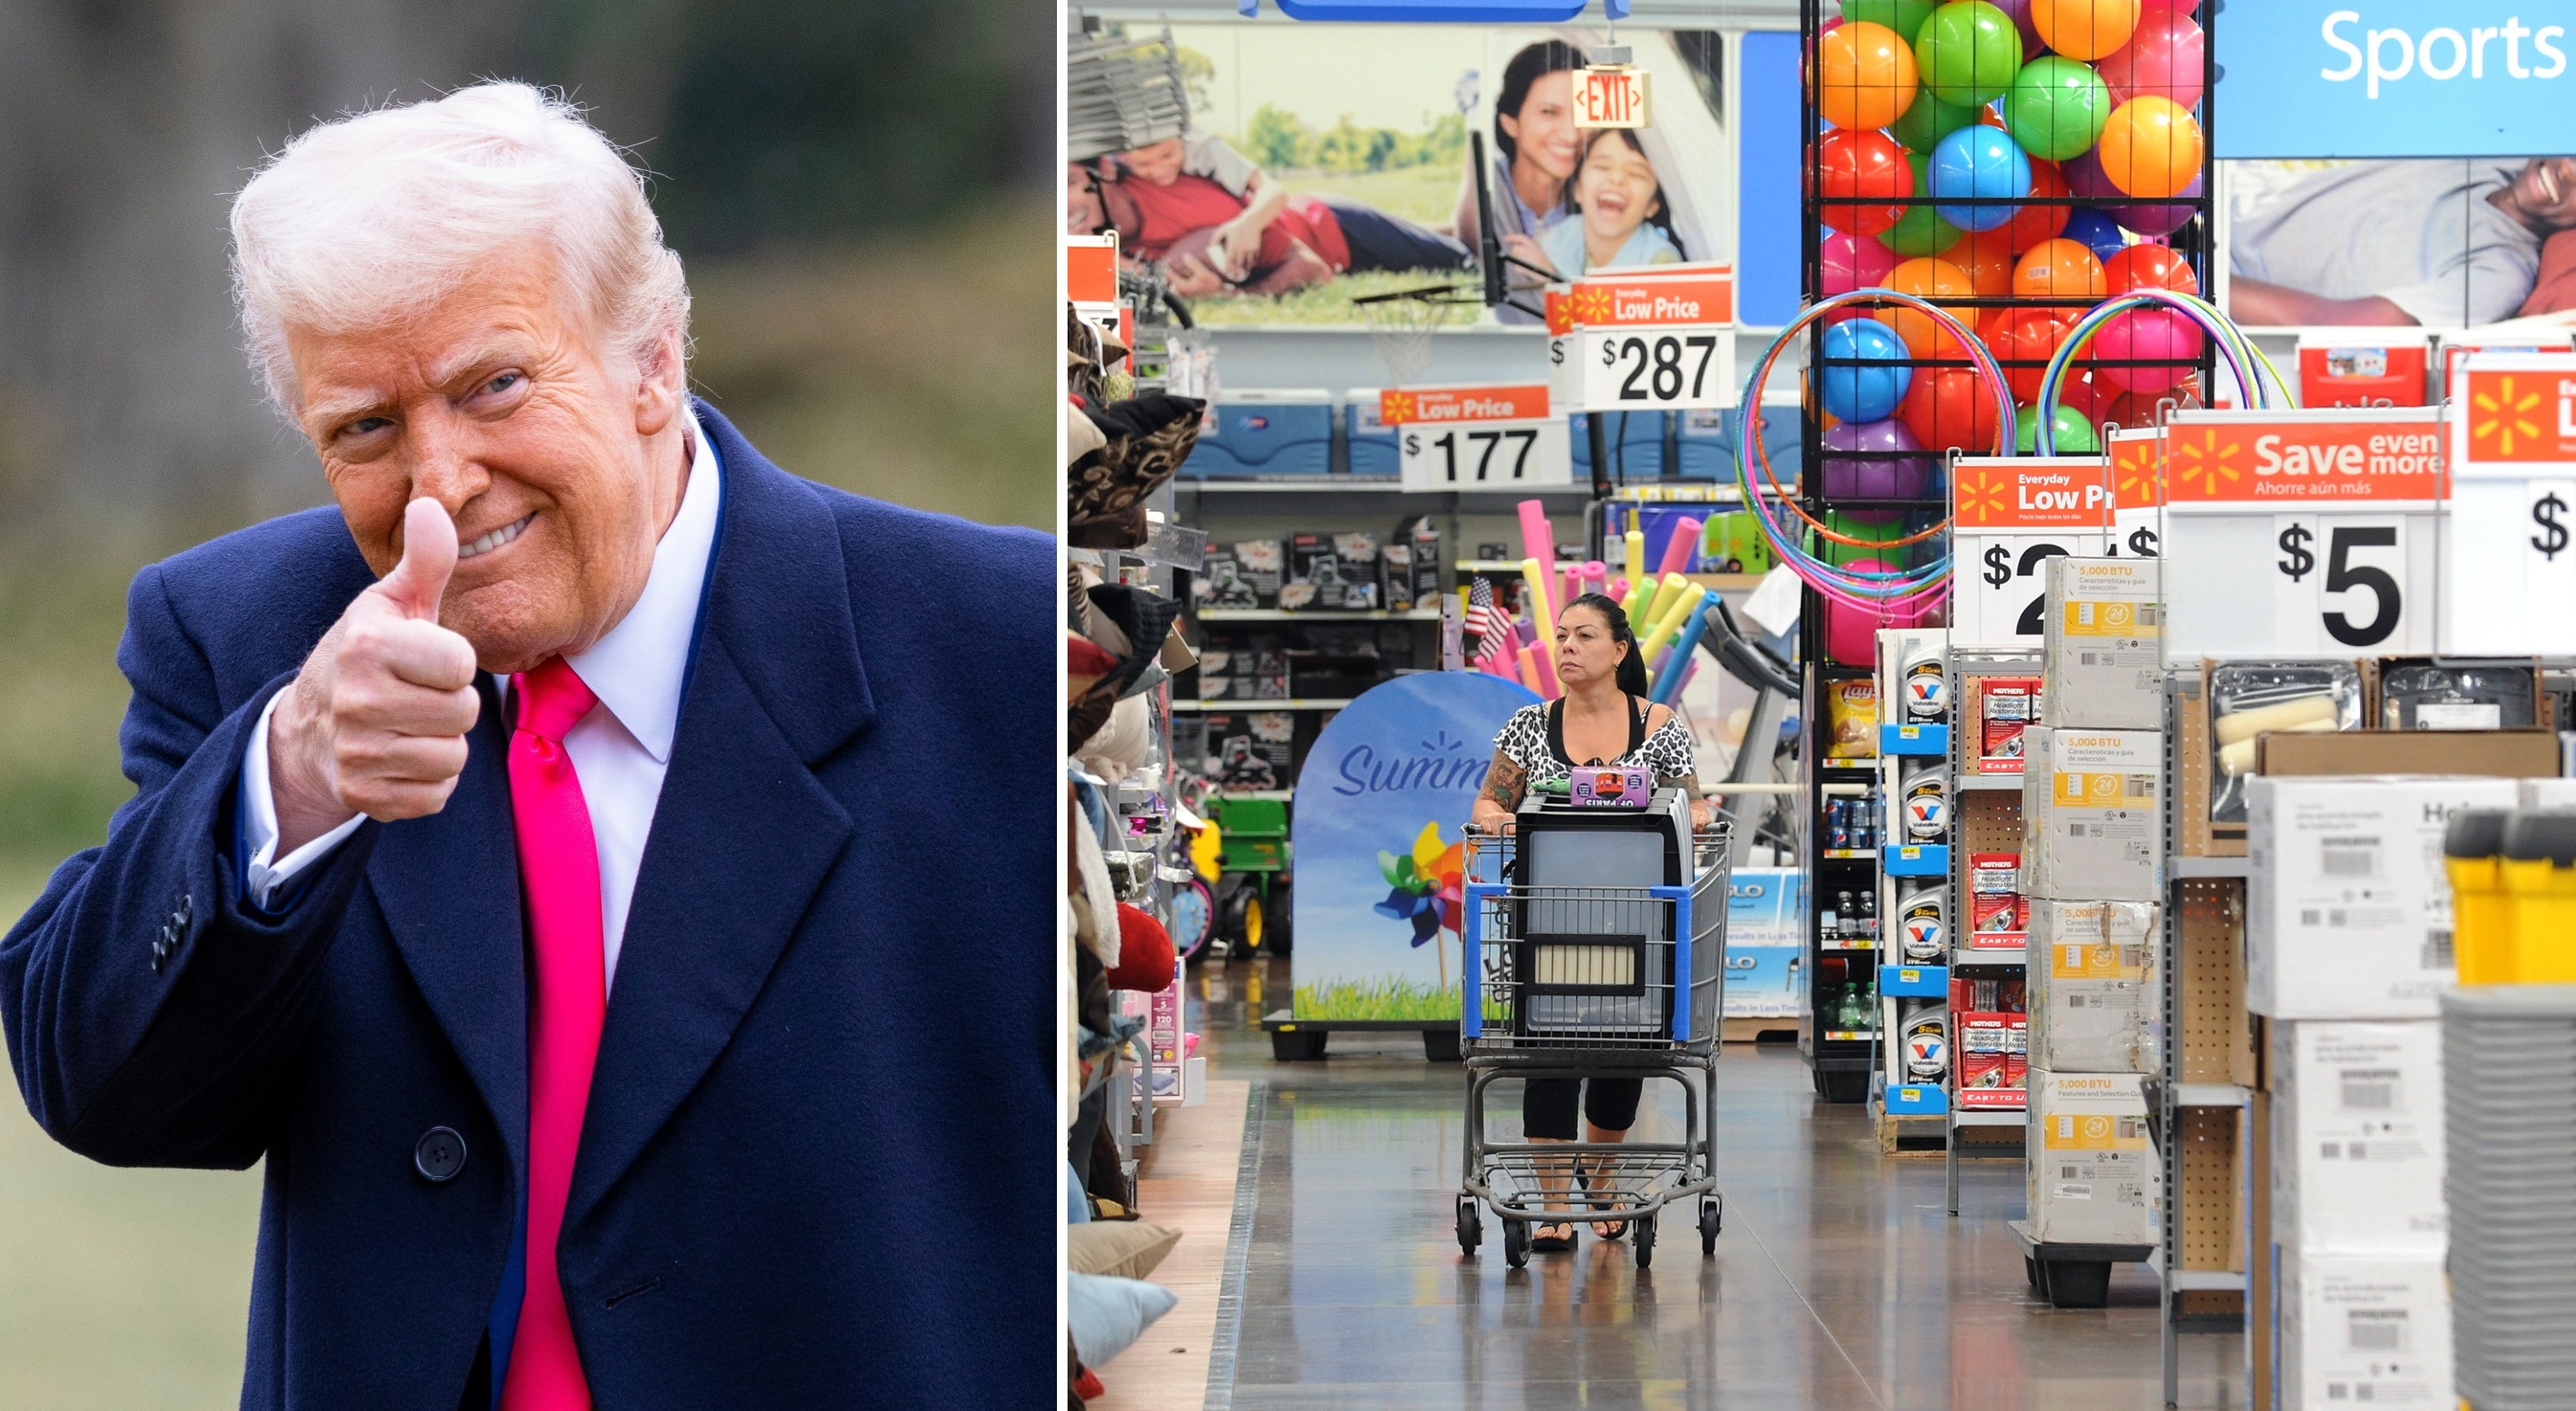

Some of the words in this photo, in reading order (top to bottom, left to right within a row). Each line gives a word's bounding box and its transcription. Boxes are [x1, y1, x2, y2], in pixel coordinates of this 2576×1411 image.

[2320, 10, 2566, 100] Sports
[1587, 75, 1631, 121] EXIT
[1615, 289, 1647, 298] Everyday
[1616, 299, 1652, 320] Low
[1655, 297, 1699, 319] Price
[1418, 403, 1459, 420] Low
[1464, 398, 1514, 417] Price
[2255, 434, 2364, 475] Save
[2369, 434, 2439, 453] even
[2369, 454, 2445, 474] more
[2018, 474, 2070, 486] Everyday
[2255, 481, 2305, 495] Ahorre
[2309, 480, 2337, 495] aún
[2341, 480, 2372, 495] más
[2018, 485, 2079, 510] Low
[2532, 492, 2570, 561] $
[2079, 567, 2108, 576] 5,000
[2110, 567, 2133, 575] BTU
[2110, 607, 2124, 617] 24
[1844, 686, 1876, 699] Lay
[2068, 737, 2096, 747] 5,000
[2099, 737, 2121, 747] BTU
[1332, 744, 1491, 797] Summ
[2099, 780, 2111, 789] 24
[2058, 1079, 2087, 1089] 5,000
[2089, 1079, 2112, 1088] BTU
[2090, 1122, 2102, 1131] 24
